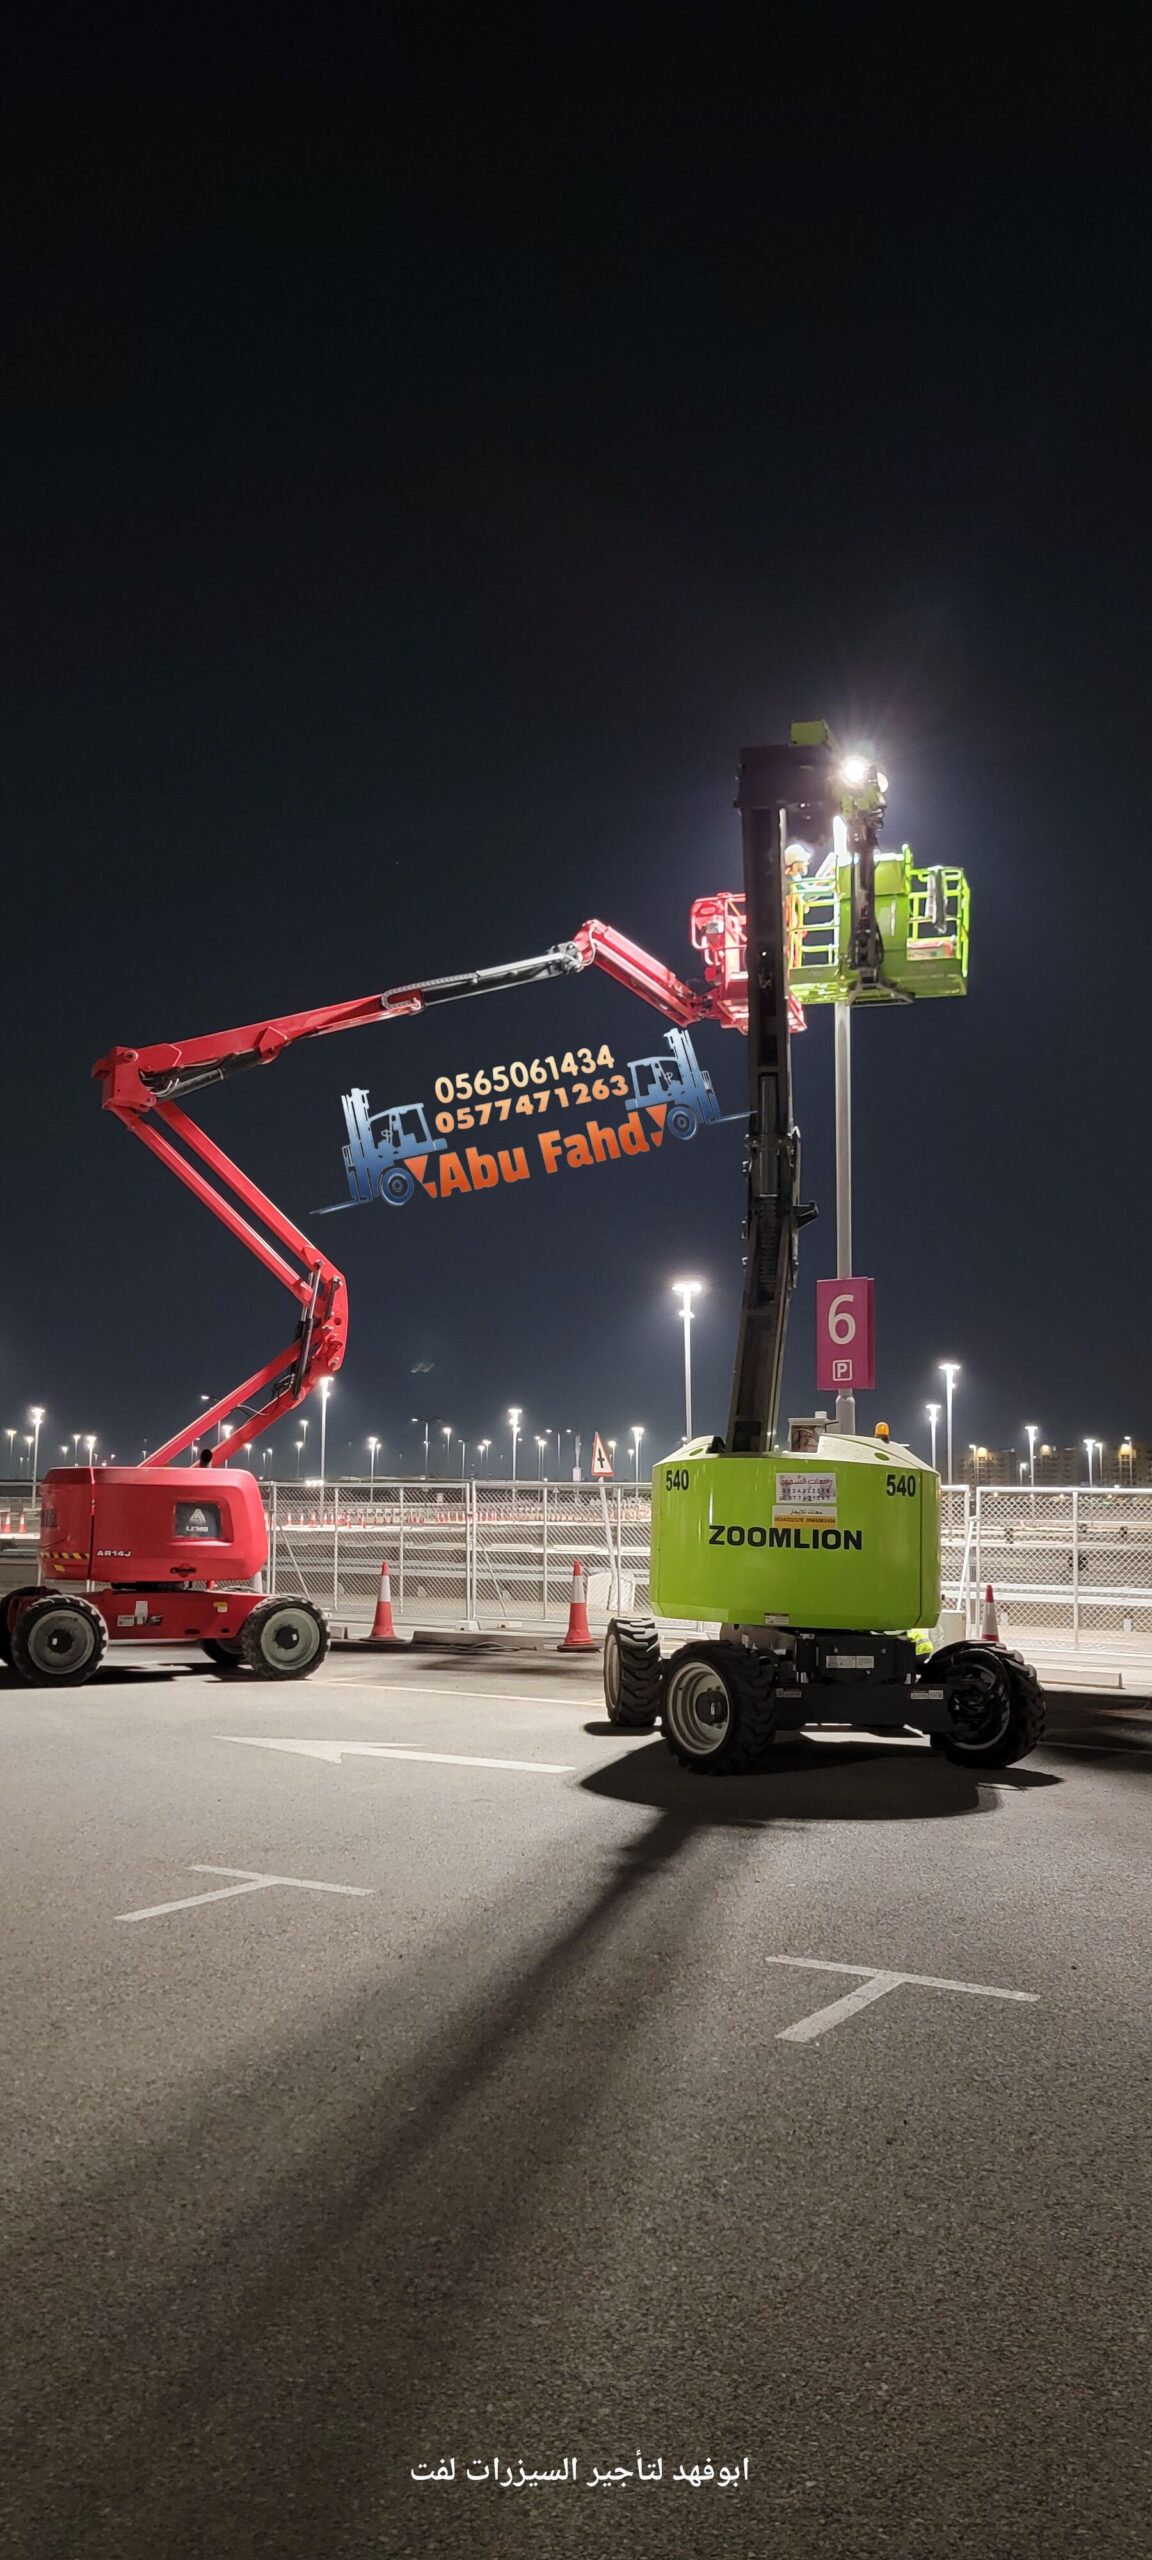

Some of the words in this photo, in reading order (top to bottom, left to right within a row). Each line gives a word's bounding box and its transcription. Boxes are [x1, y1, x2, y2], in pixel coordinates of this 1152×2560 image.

[828, 1294, 857, 1345] 6
[665, 1469, 689, 1491] 540
[886, 1474, 916, 1498] 540
[708, 1525, 862, 1550] ZOOMLION
